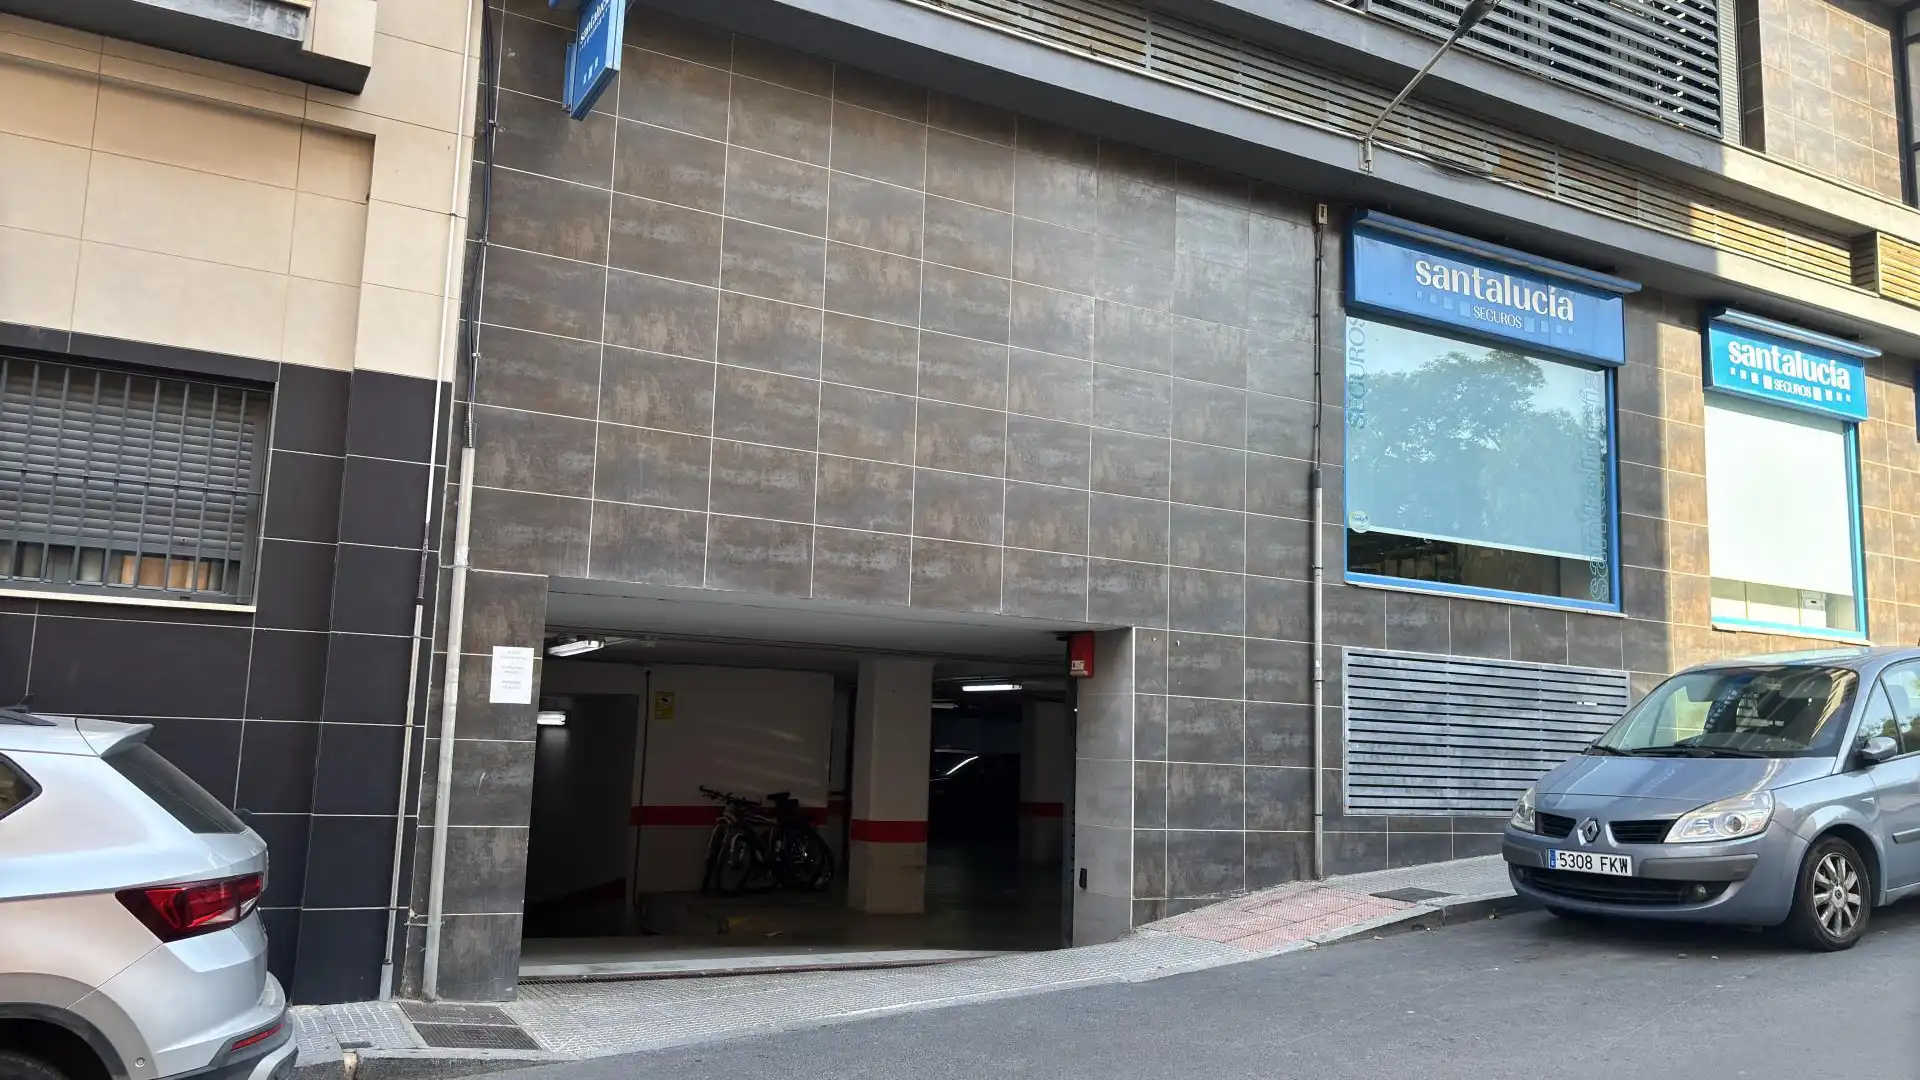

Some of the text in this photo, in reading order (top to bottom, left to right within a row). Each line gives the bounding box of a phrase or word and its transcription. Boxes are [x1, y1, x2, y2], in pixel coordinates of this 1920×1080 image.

[1415, 260, 1574, 321] santalucía
[1473, 306, 1522, 329] SEGUROS
[1728, 341, 1850, 390] santalucía
[1773, 378, 1812, 398] SEGUROS
[1559, 852, 1628, 874] 5308 FKW
